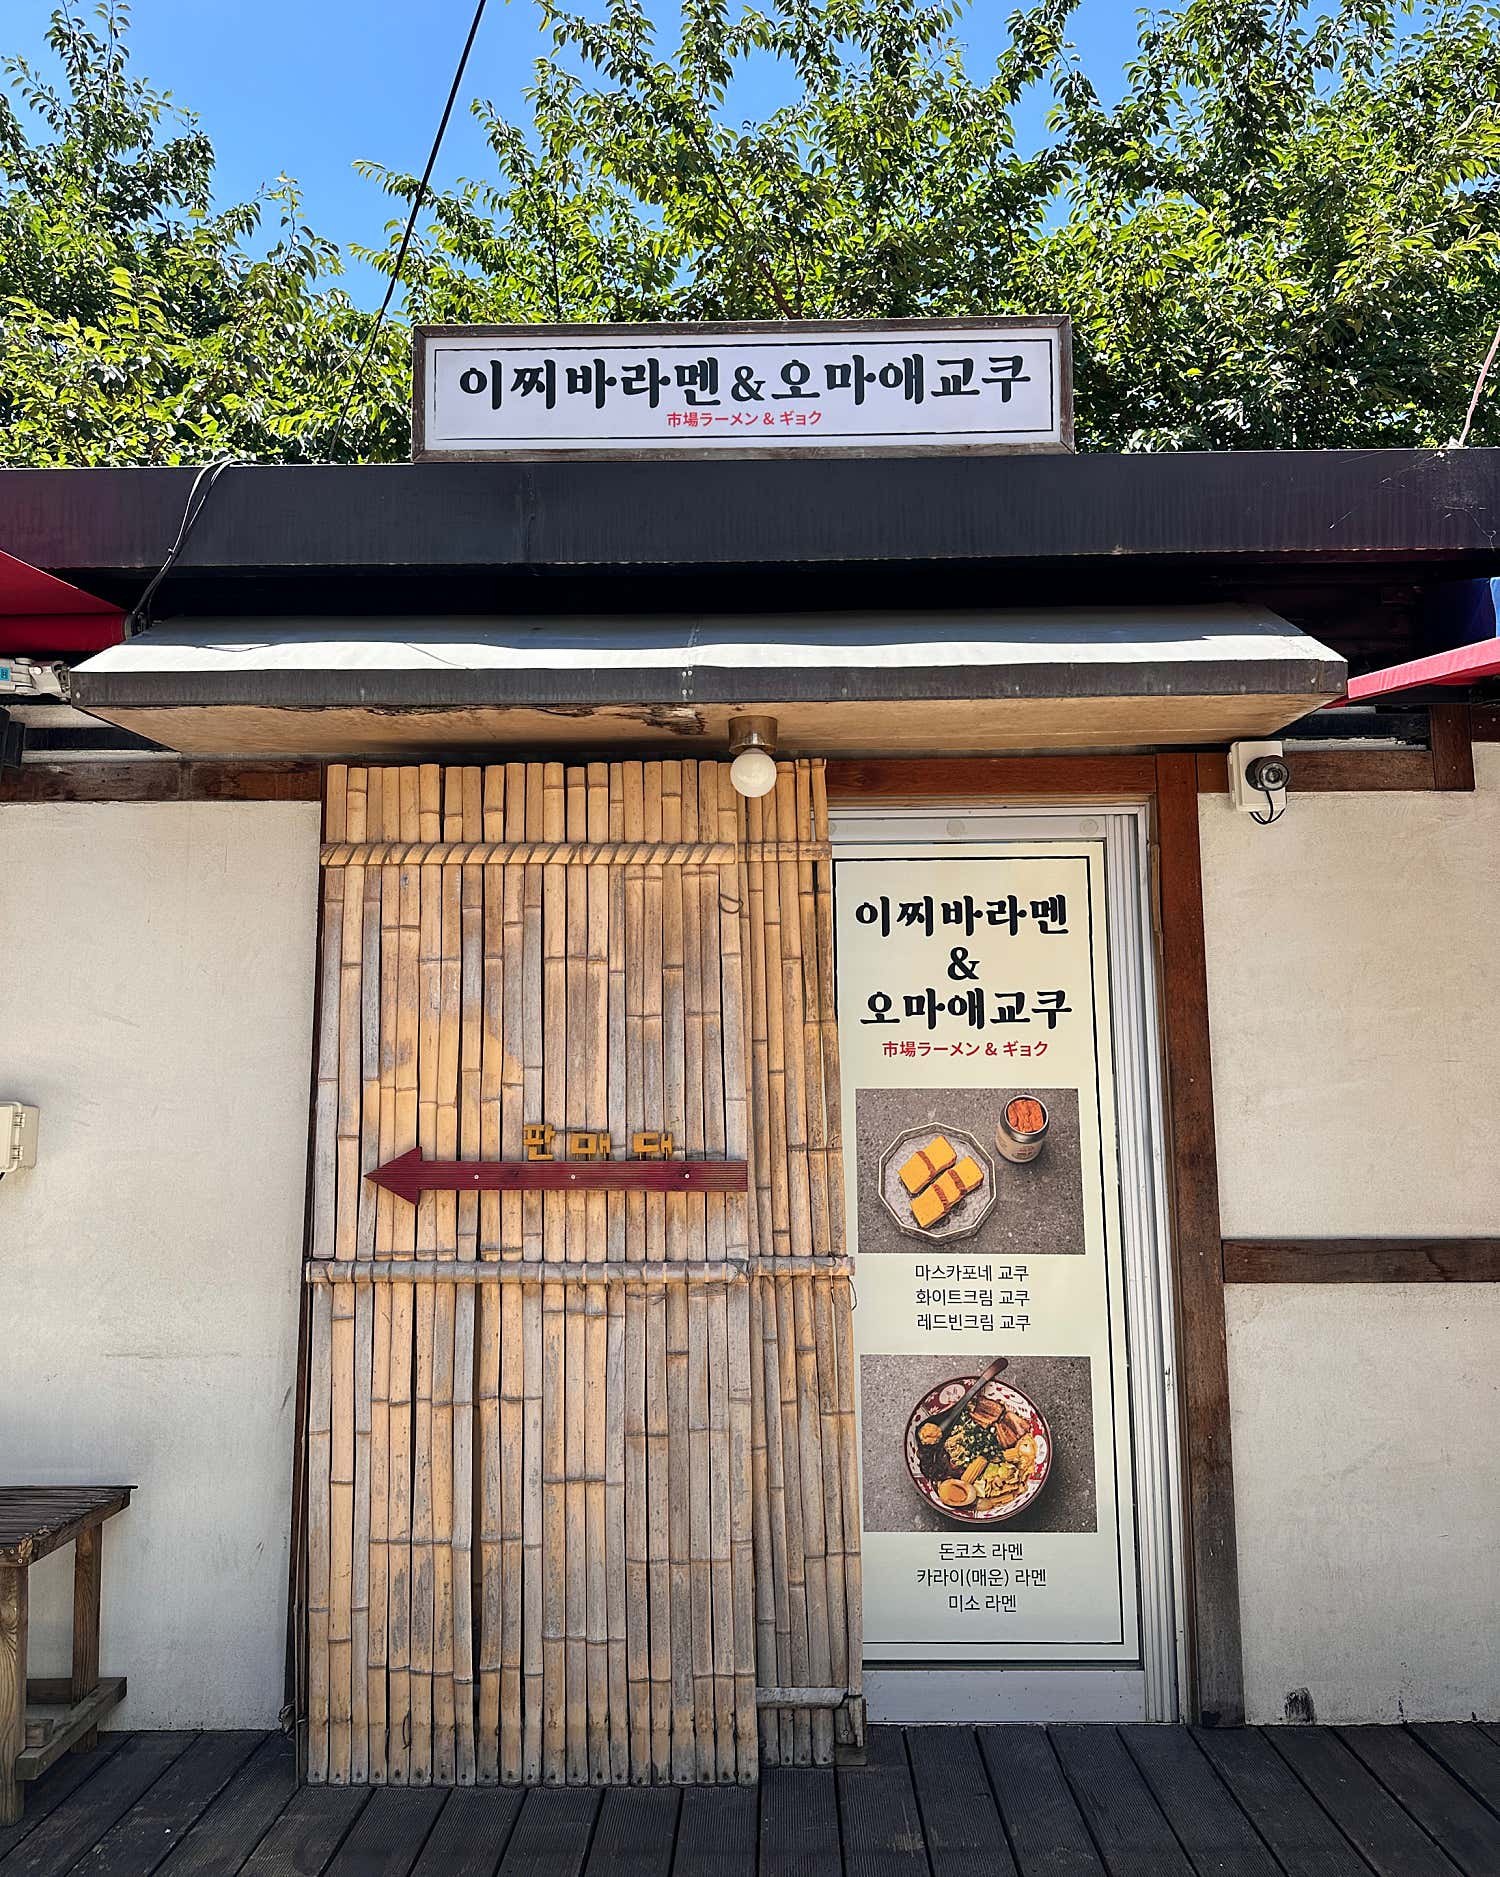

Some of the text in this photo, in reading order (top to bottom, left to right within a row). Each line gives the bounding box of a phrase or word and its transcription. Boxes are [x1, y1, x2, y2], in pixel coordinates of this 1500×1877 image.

[668, 411, 759, 428] 市場ラーメン
[780, 411, 822, 426] ギョク
[855, 894, 1069, 937] 이찌바라멘
[947, 946, 981, 981] &
[860, 987, 1073, 1030] 오마애교쿠
[882, 1041, 980, 1058] 市場ラーメン
[1001, 1041, 1049, 1057] ギョク
[915, 1264, 1029, 1282] 마스카포네 교쿠
[915, 1289, 1030, 1307] 화이트크림 교쿠
[917, 1313, 1031, 1332] 레드빈크림 교쿠
[938, 1542, 1024, 1561] 돈코츠 라멘
[916, 1568, 1047, 1588] 카라이(매운) 라멘
[949, 1594, 1017, 1613] 미소 라멘
